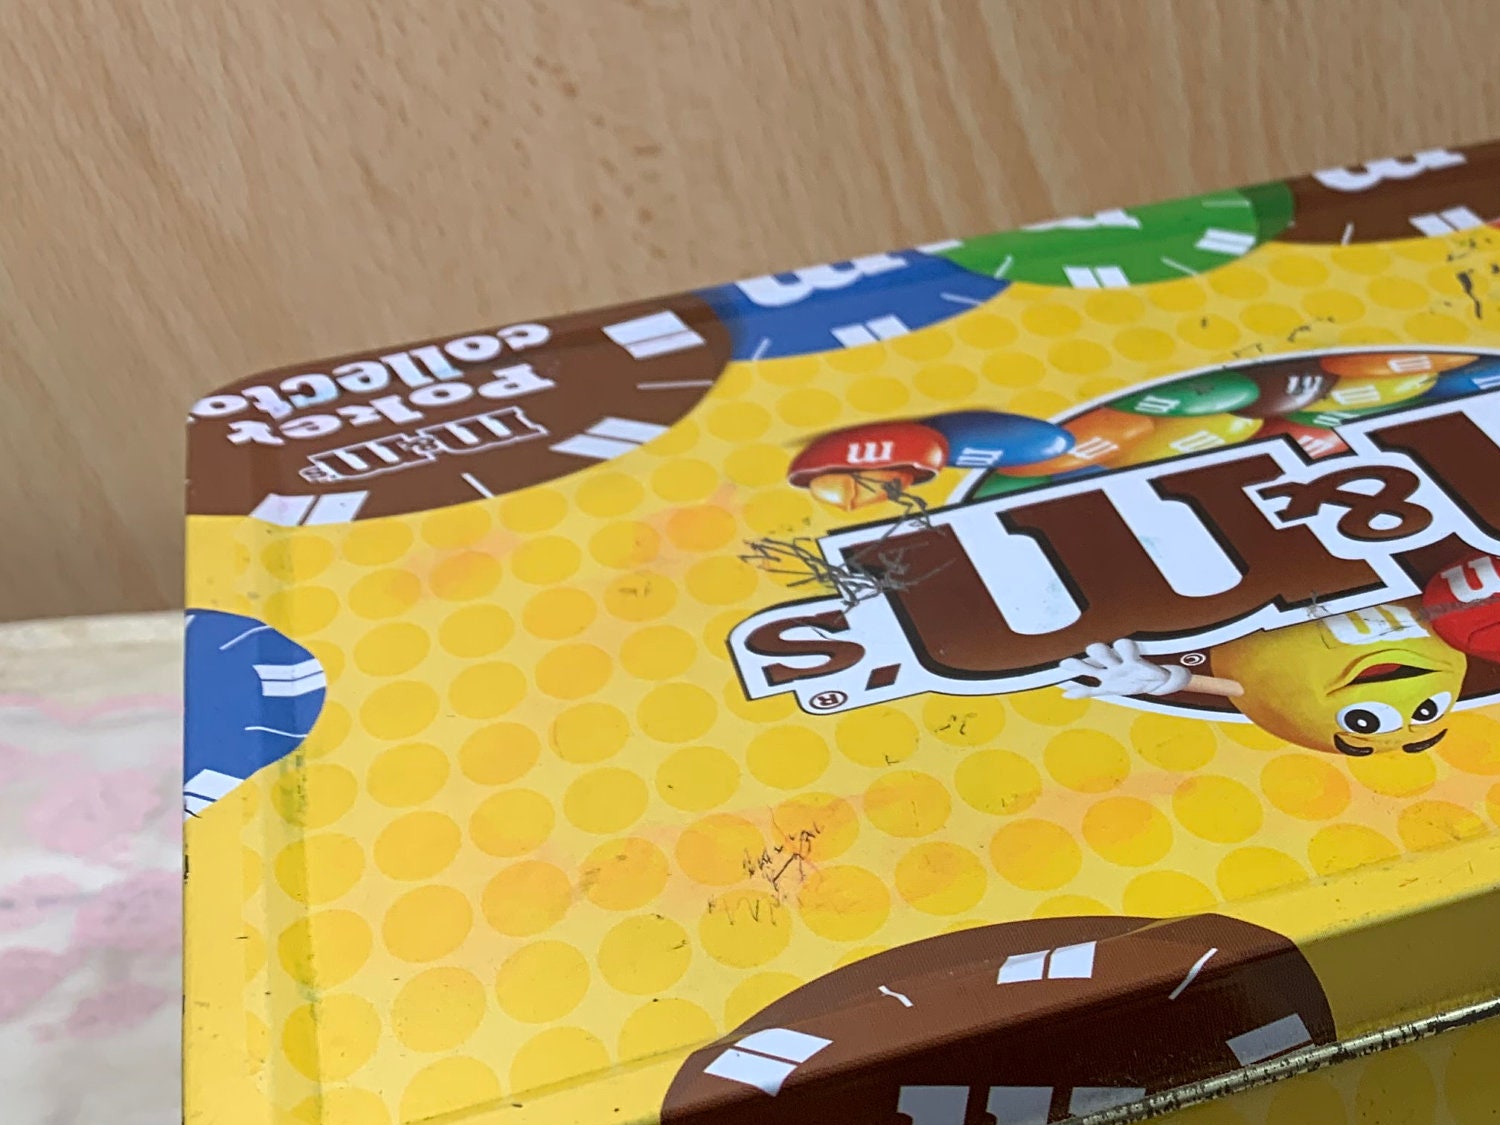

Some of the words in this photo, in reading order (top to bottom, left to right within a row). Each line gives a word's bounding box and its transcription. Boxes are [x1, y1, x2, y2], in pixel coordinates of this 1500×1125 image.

[187, 323, 551, 426] collecto
[226, 363, 556, 446] Poker
[847, 440, 894, 464] m
